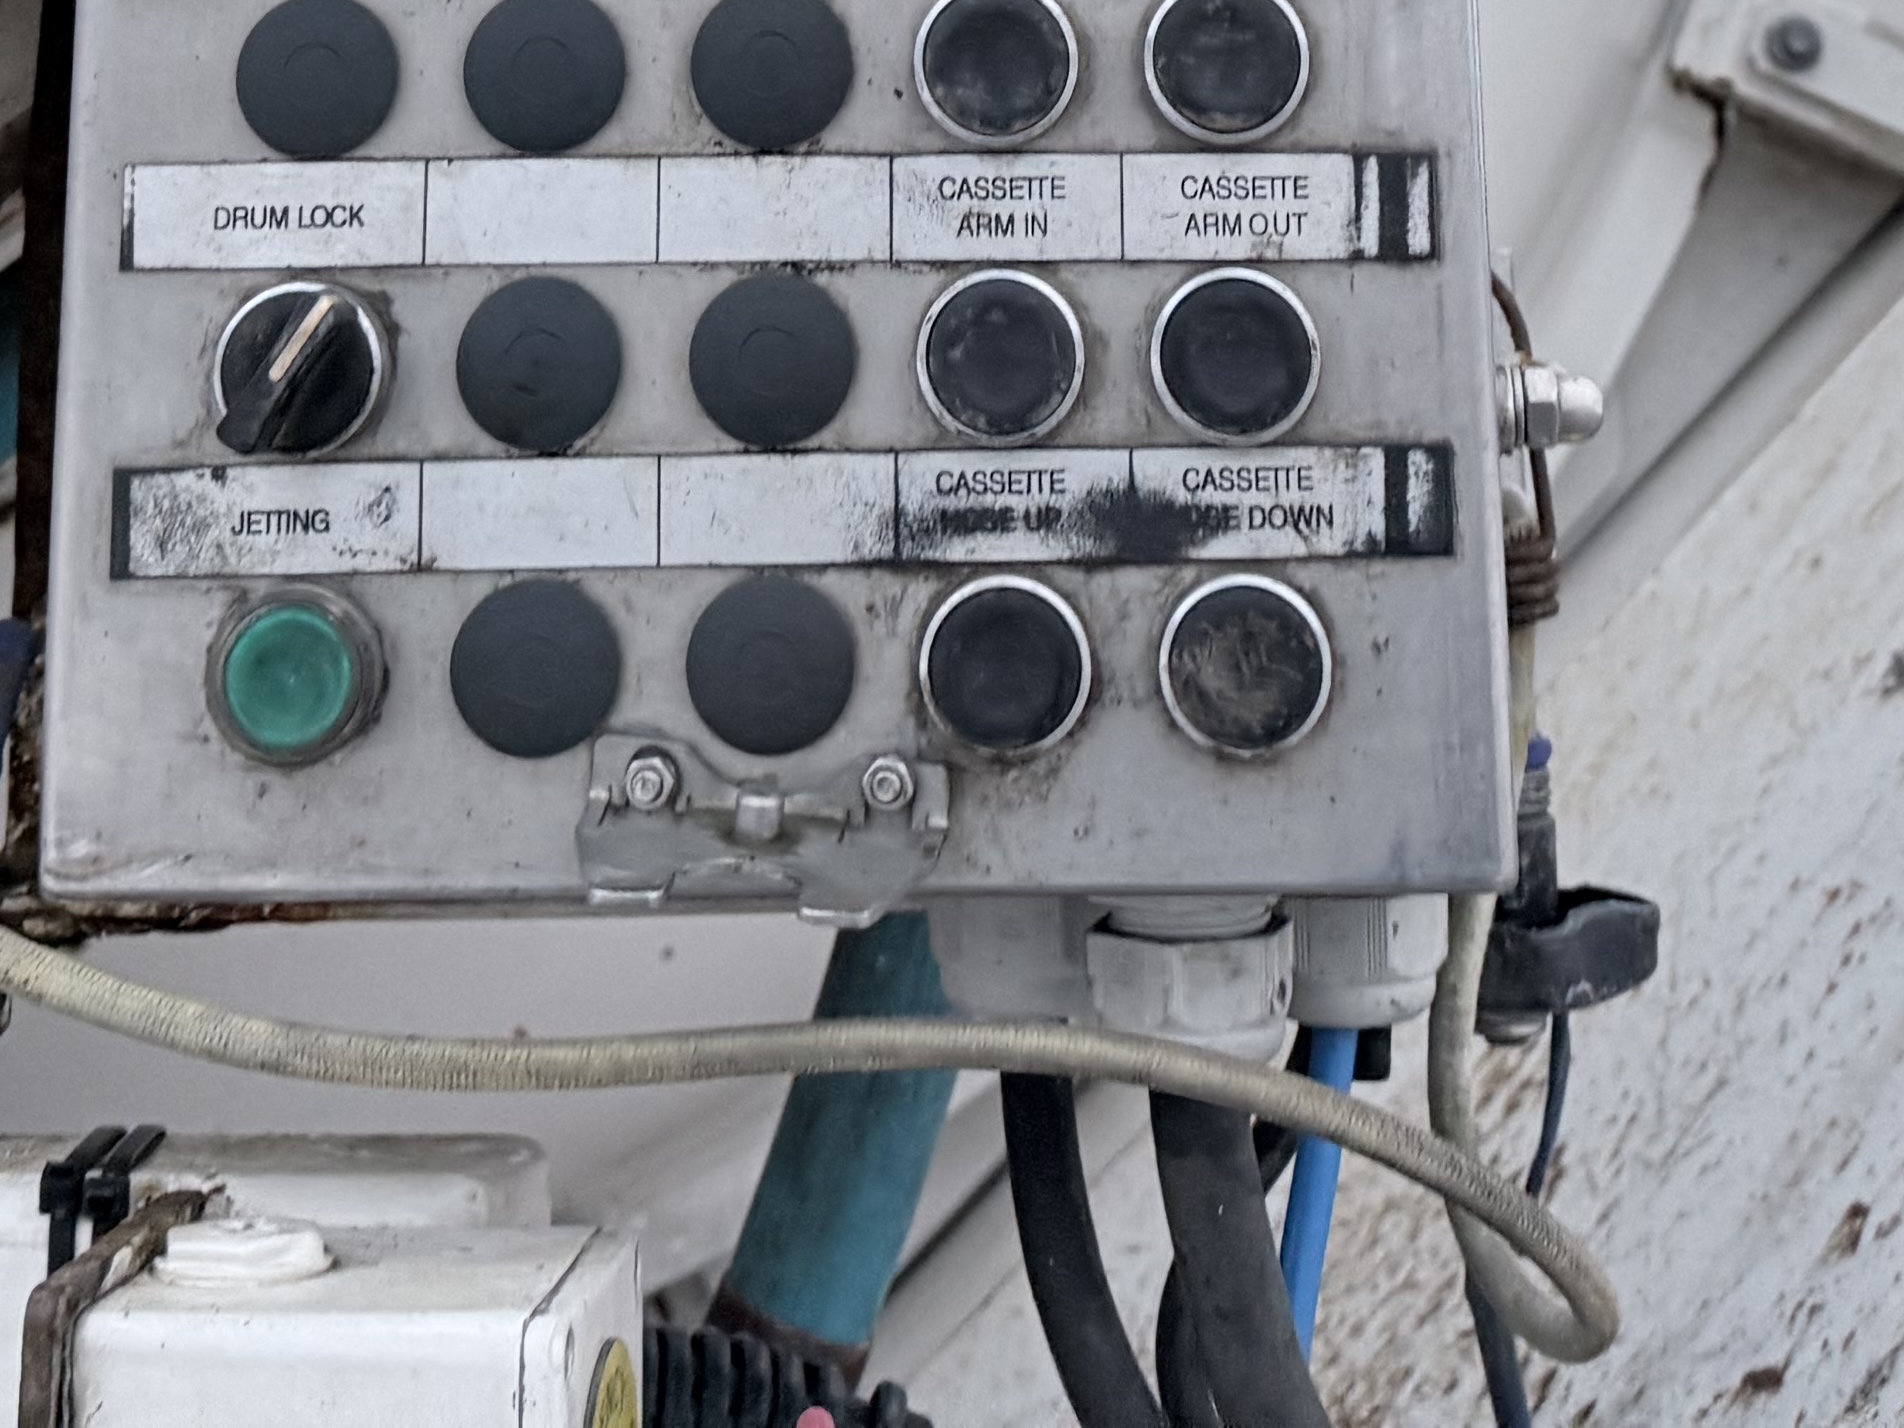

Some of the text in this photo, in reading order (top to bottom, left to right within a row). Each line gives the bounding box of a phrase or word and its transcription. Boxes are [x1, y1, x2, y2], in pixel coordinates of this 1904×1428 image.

[938, 175, 1067, 201] CASSETTE
[1180, 174, 1310, 201] CASSETTE
[213, 203, 366, 231] DRUM LOCK
[956, 211, 1049, 238] ARM IN
[1184, 211, 1308, 238] ARM OUT
[935, 469, 1067, 497] CASSETTE
[1181, 466, 1314, 494] CASSETTE
[230, 508, 332, 537] JETTING
[1247, 502, 1335, 532] DOWN
